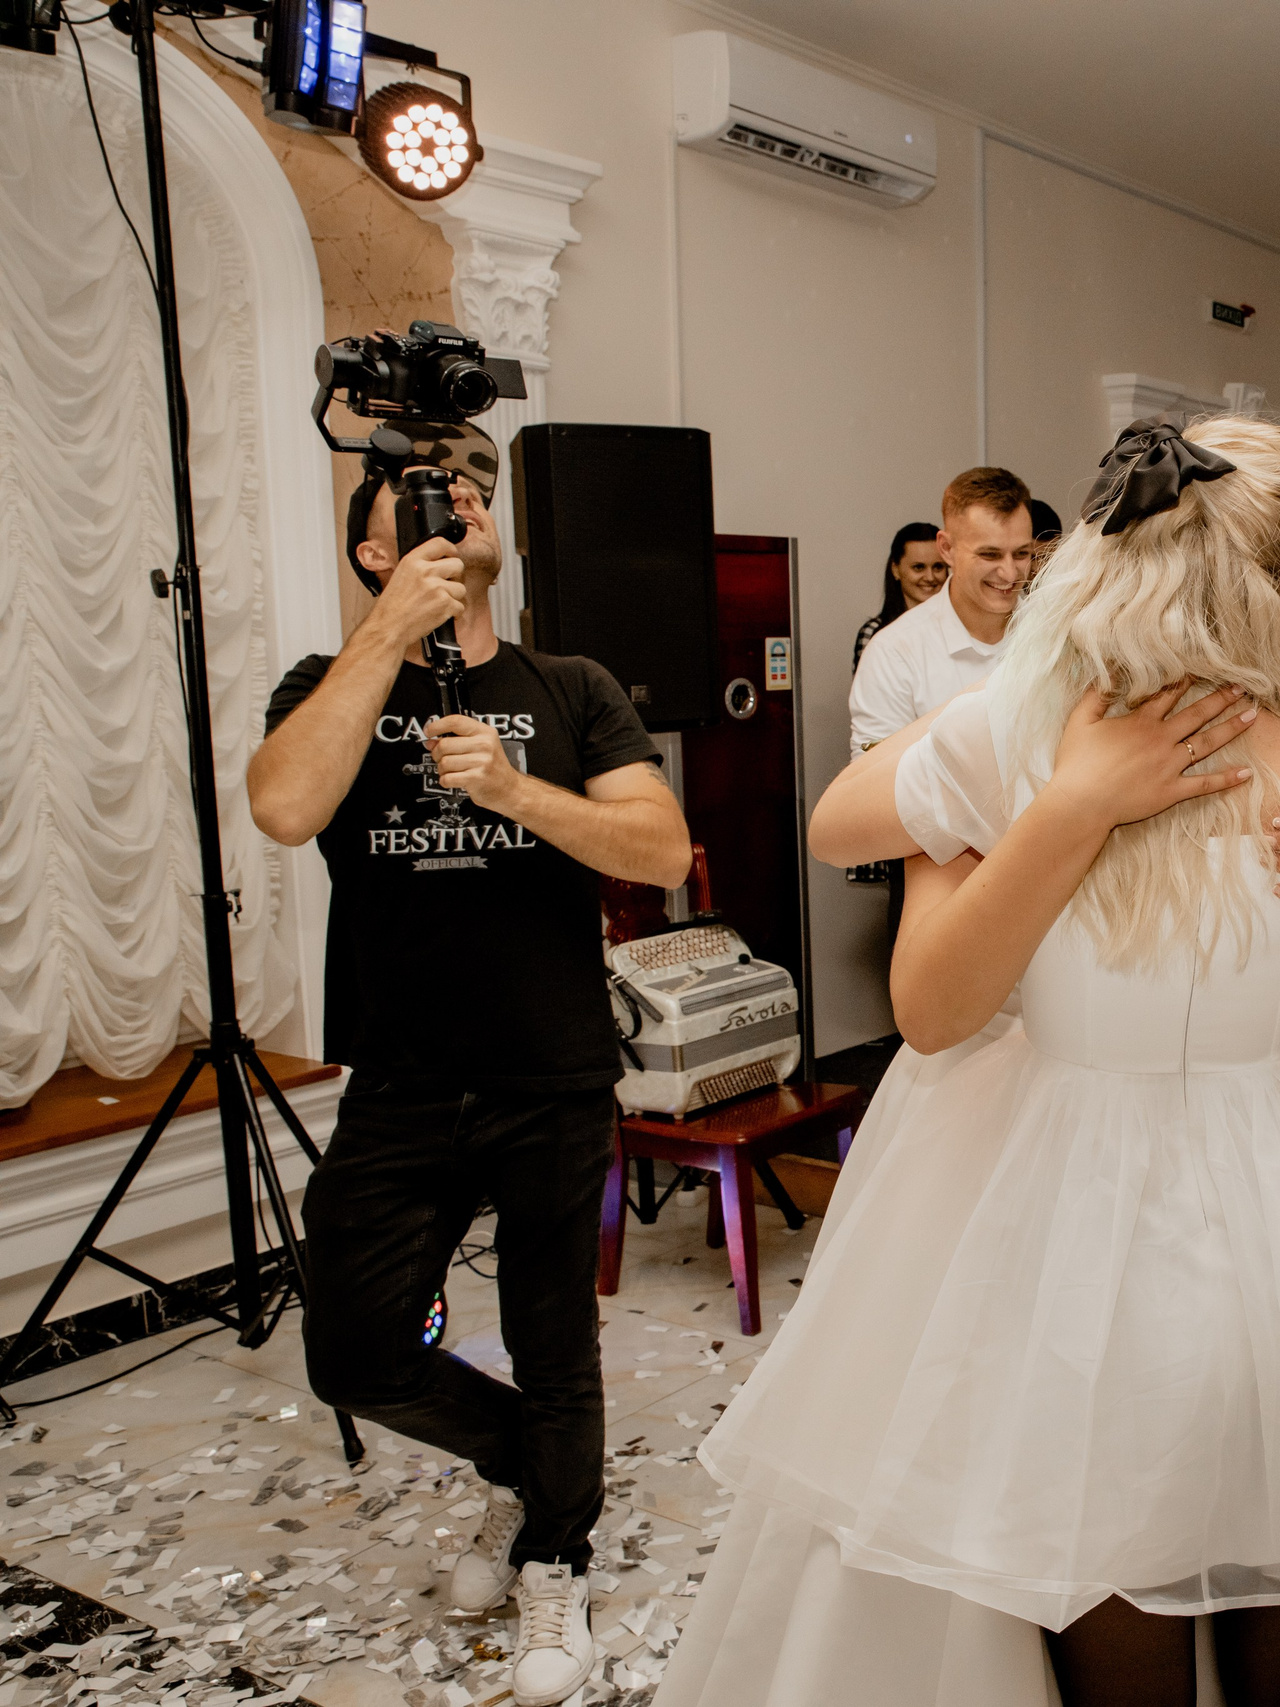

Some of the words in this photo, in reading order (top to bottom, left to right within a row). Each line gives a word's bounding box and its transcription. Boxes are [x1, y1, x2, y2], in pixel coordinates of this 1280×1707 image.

[438, 338, 463, 346] FUJIFILM
[374, 713, 536, 743] CAES
[369, 824, 537, 855] FESTIVAL
[421, 858, 478, 869] OFFICIAL
